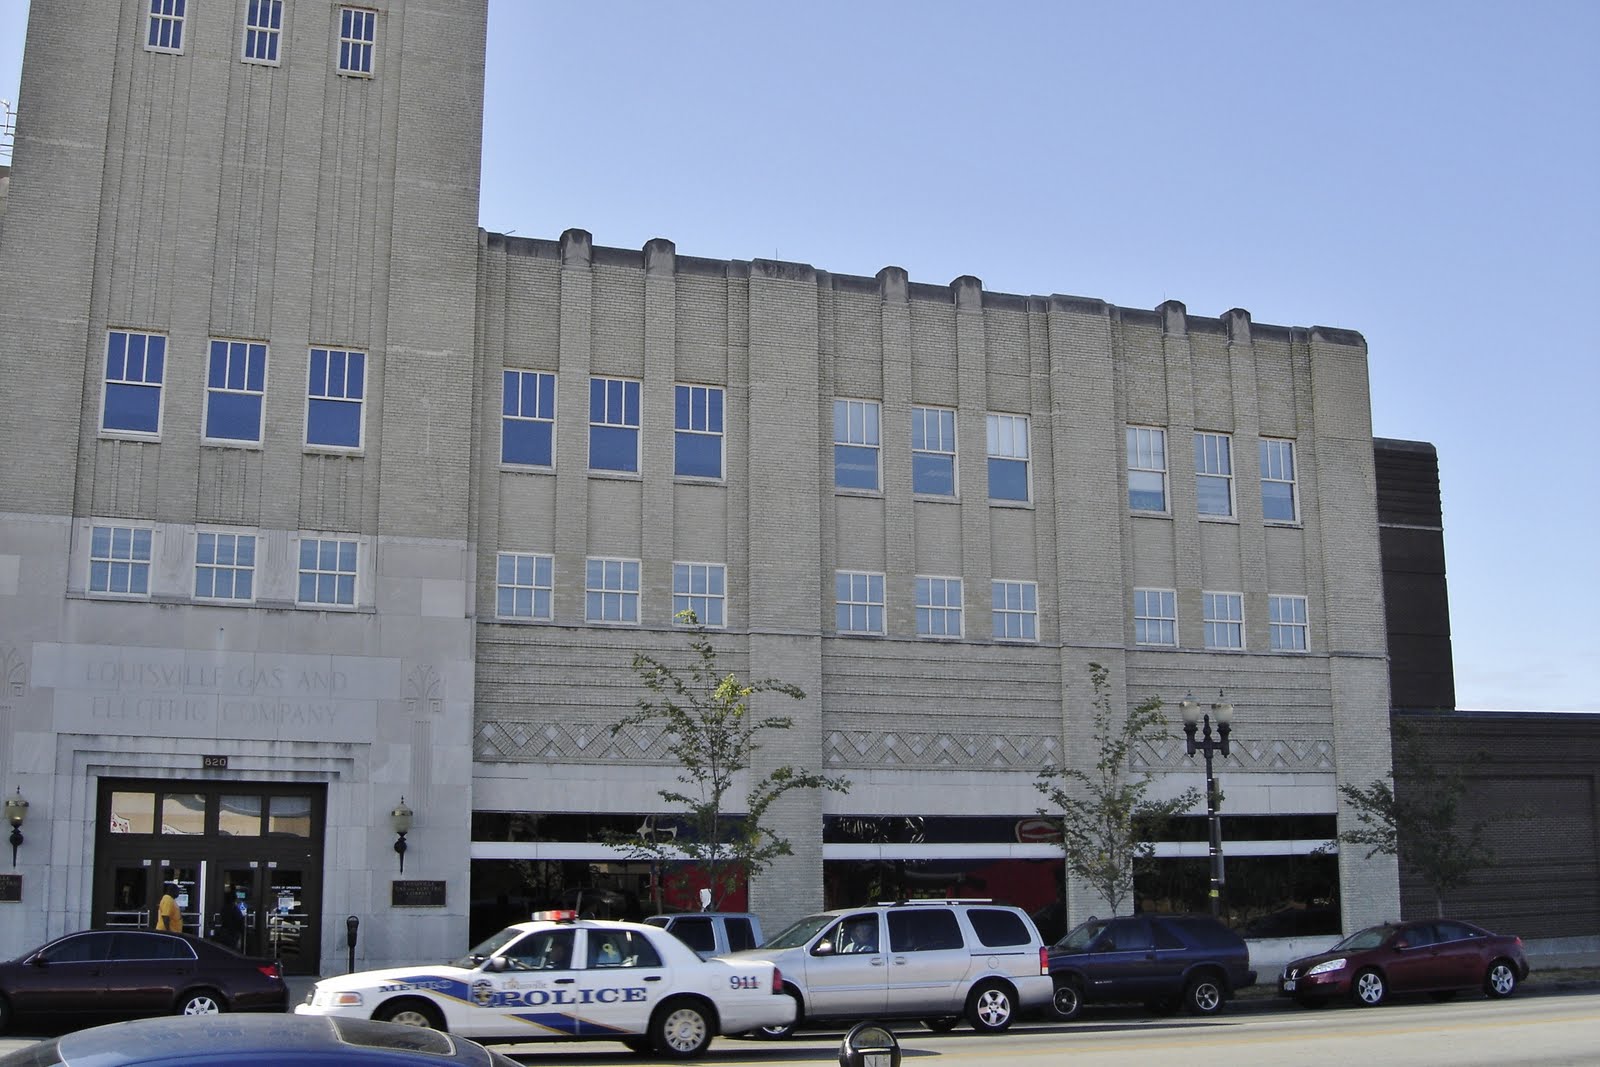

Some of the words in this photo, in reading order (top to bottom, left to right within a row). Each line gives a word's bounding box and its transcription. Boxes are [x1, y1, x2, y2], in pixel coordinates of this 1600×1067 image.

[86, 662, 224, 688] LOUISVILLE
[236, 665, 284, 690] GAS
[298, 669, 347, 692] AND
[91, 696, 207, 721] ELECTRIC
[223, 701, 338, 726] COMPANY
[204, 757, 227, 766] 820
[378, 980, 453, 993] METRO
[730, 975, 760, 990] 911
[494, 987, 648, 1008] POLICE
